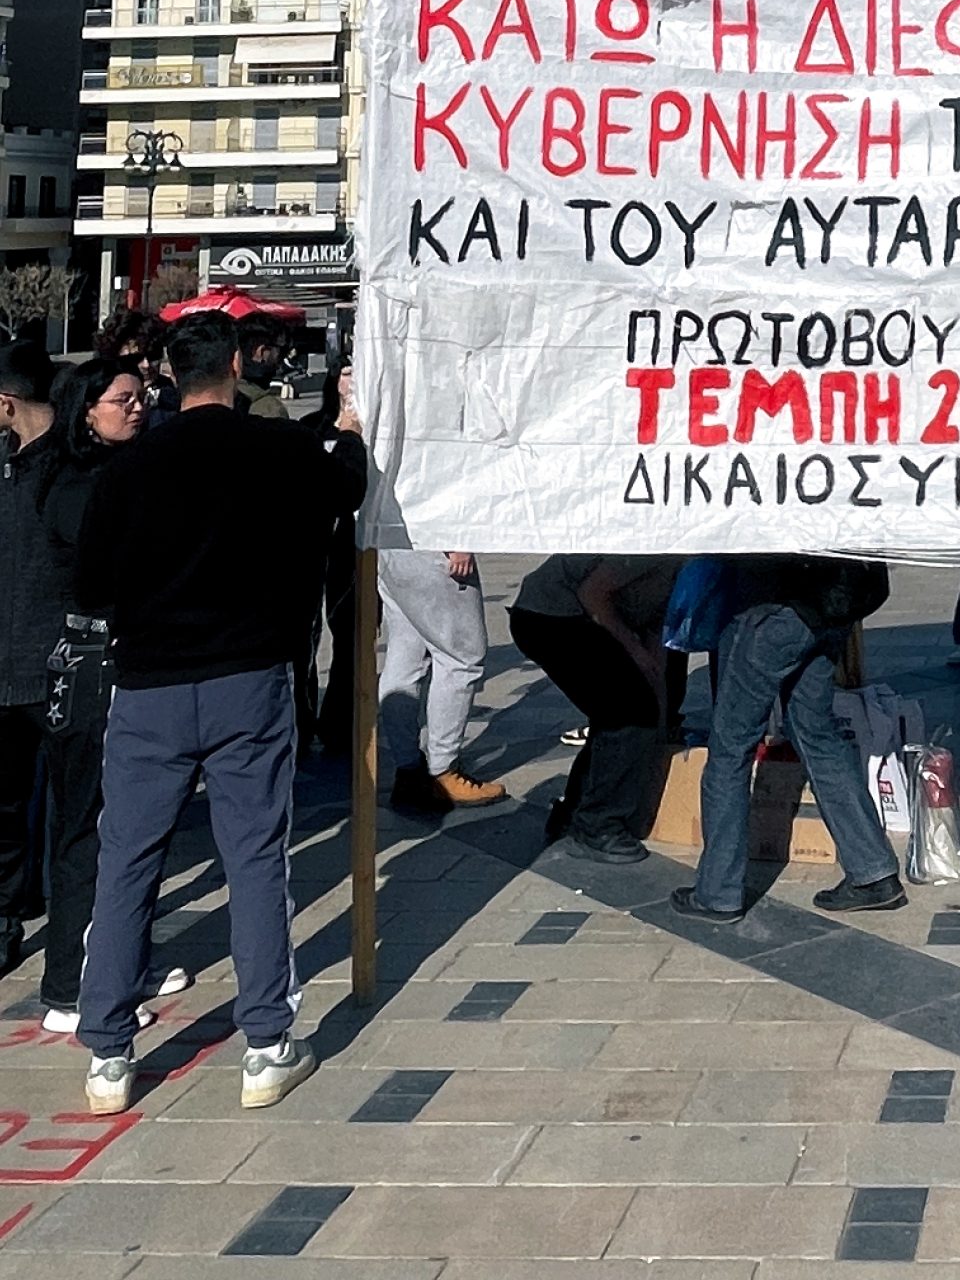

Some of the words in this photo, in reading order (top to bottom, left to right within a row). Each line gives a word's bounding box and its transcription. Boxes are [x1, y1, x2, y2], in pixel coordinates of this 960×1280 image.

[413, 81, 901, 181] ΚΥΒΕΡΝΗΣΗ
[262, 244, 347, 264] ΠΑΠΑΔΑΚΗΣ
[407, 195, 530, 267] ΚΑΙ
[564, 198, 718, 270] ΤΟΥ
[625, 367, 901, 447] ΤΕΜΠΗ
